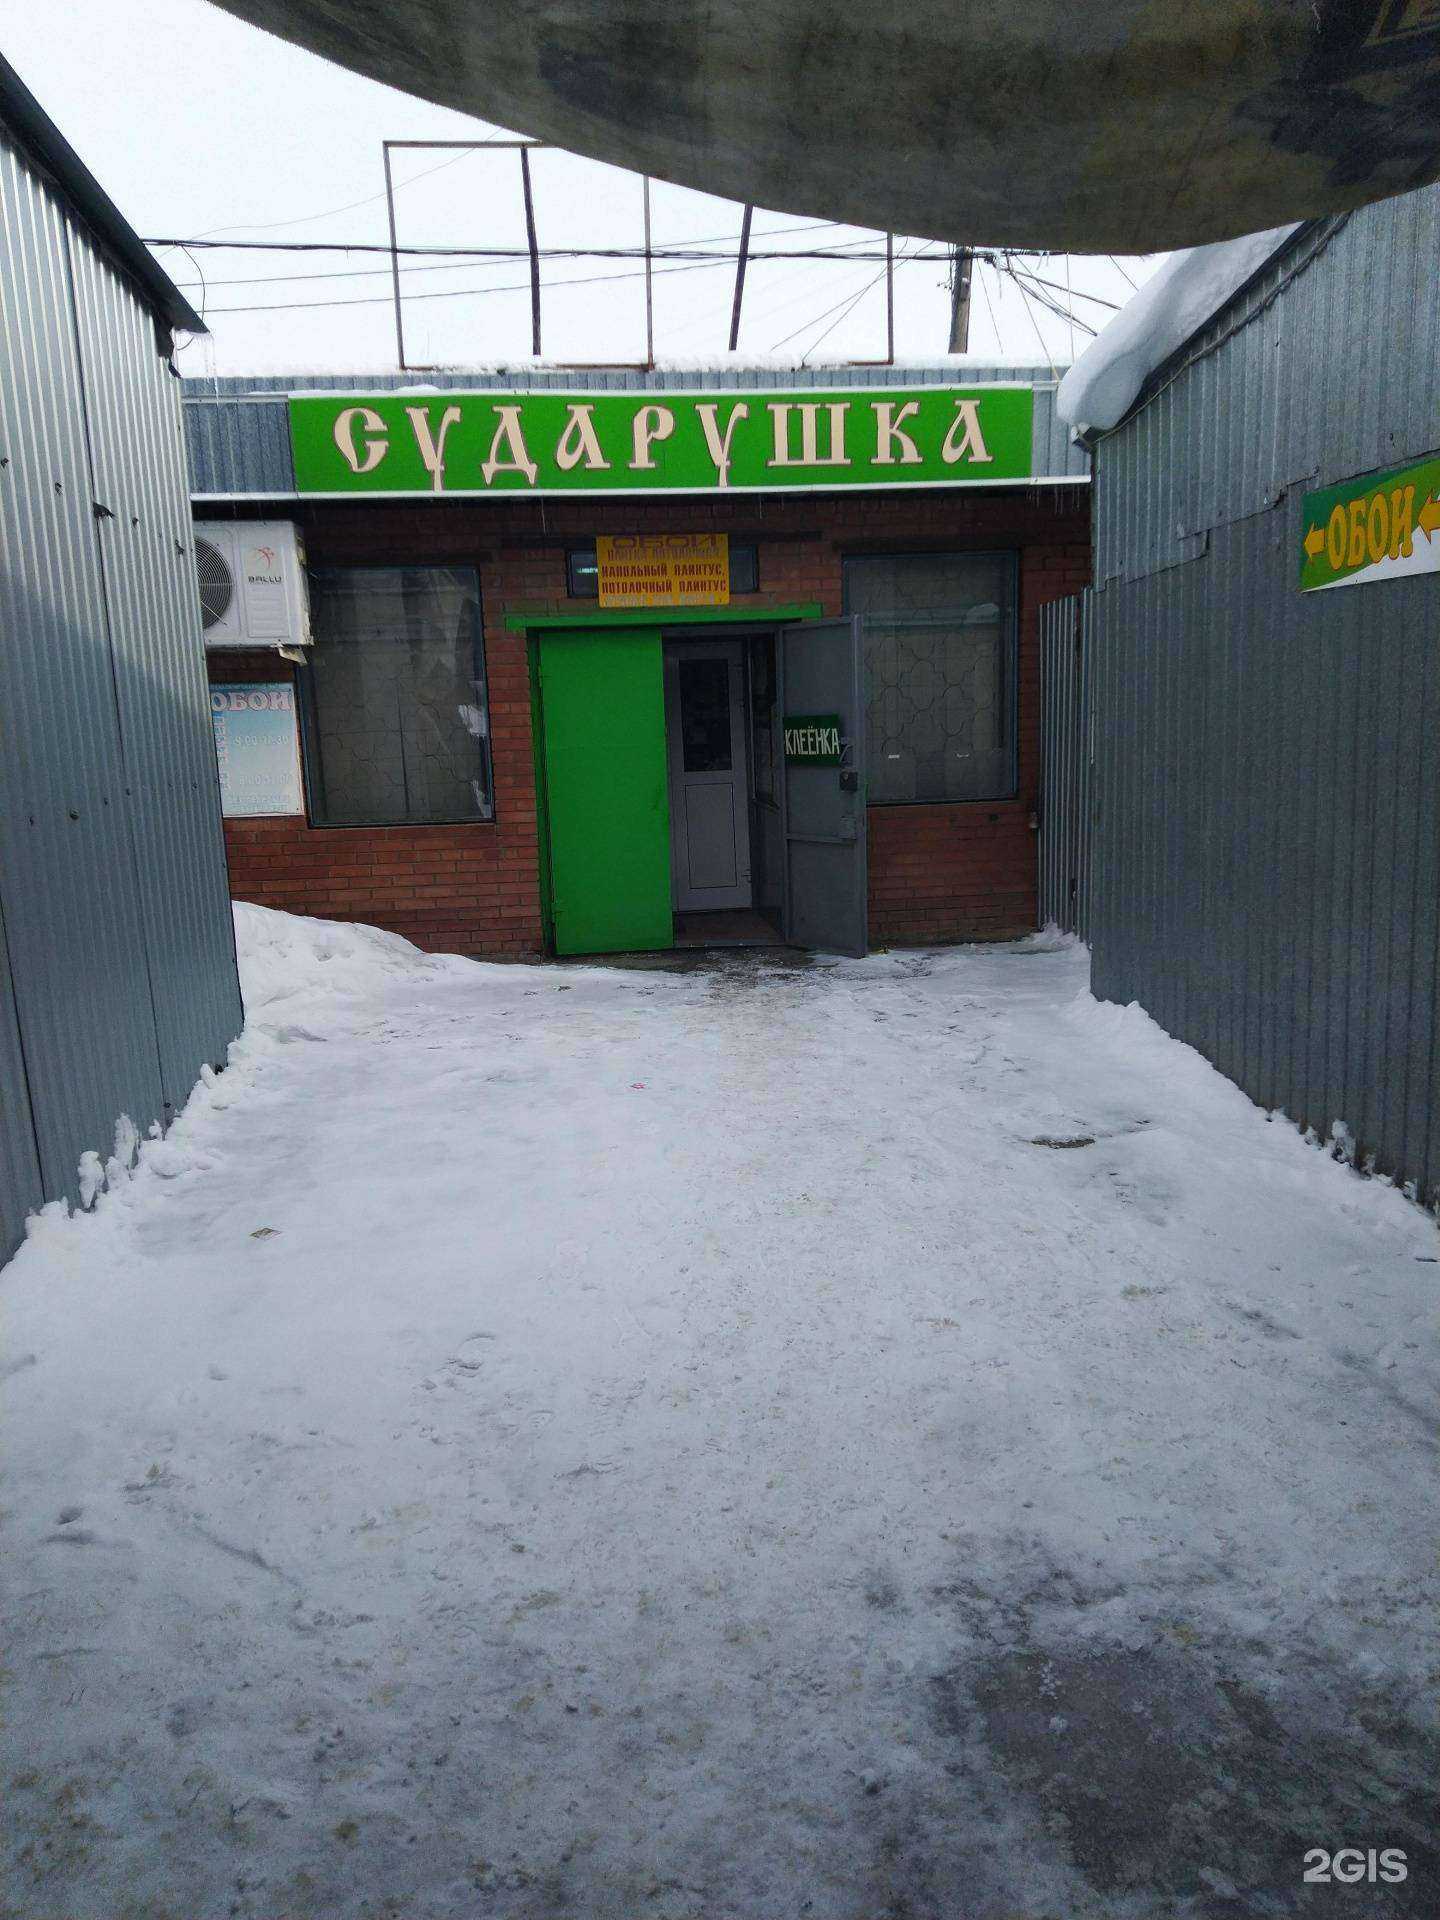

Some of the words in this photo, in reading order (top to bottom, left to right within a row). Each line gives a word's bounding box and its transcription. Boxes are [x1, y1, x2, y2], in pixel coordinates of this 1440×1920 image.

[333, 399, 994, 492] СУДАРУШКА
[1327, 484, 1415, 571] ОБОИ
[613, 534, 717, 548] ОБОИ
[601, 564, 667, 577] НАПОЛЬНЫЙ
[602, 581, 672, 594] ПОТОЛОЧНЫЙ
[679, 580, 726, 592] ПЛИНТУС
[210, 691, 291, 711] ОБОИ
[785, 725, 840, 754] КЛЕЁНКА
